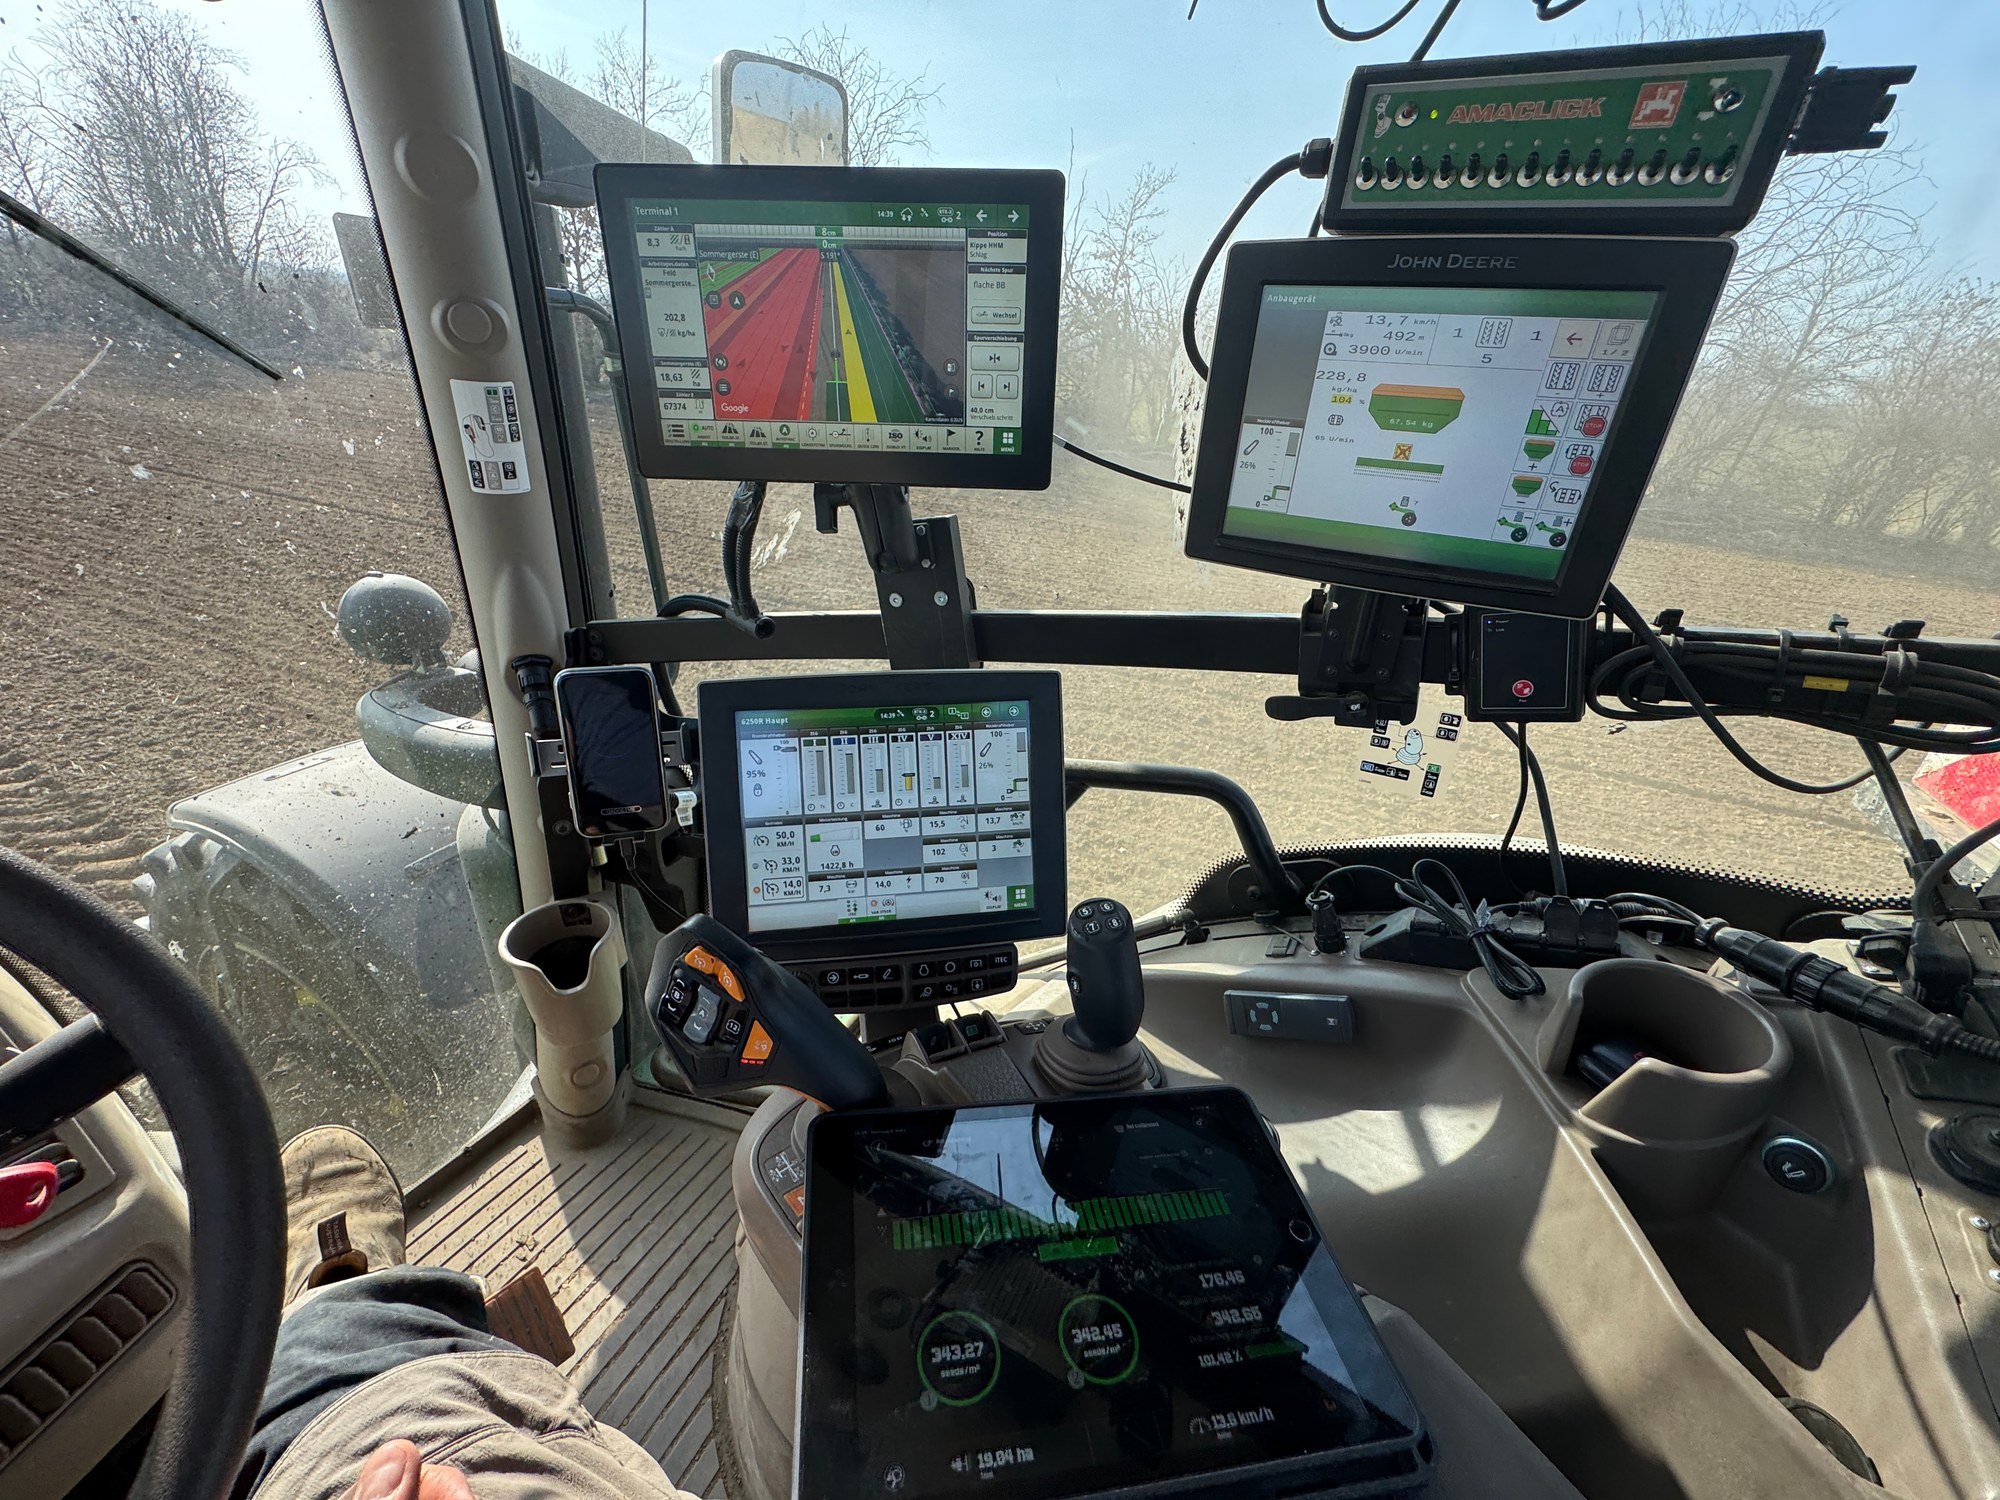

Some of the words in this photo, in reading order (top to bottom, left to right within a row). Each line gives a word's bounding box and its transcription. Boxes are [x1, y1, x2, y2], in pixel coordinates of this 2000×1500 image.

[1446, 97, 1607, 124] AMACLICK
[635, 206, 672, 216] Terminal
[674, 207, 679, 216] 1
[877, 210, 894, 218] 14:39
[956, 211, 961, 220] 2
[647, 238, 660, 248] 8,3
[969, 242, 986, 250] Kippe
[699, 250, 748, 260] Sommergerste
[750, 250, 759, 259] (E)
[969, 251, 987, 259] Schlag
[1387, 254, 1442, 268] JOHN
[1446, 254, 1519, 268] DEERE
[996, 281, 1005, 289] BB
[1267, 294, 1316, 304] Anbaugerät
[664, 313, 686, 322] 202,8
[1365, 315, 1409, 327] 13,7
[1413, 318, 1437, 326] km/h
[677, 330, 696, 338] kg/ha
[1383, 331, 1416, 341] 492
[1452, 328, 1463, 338] 1
[1530, 331, 1542, 341] 1
[1348, 345, 1391, 355] 3900
[1481, 354, 1493, 364] 5
[660, 373, 683, 382] 18,63
[1315, 370, 1367, 383] 228,8
[1331, 396, 1352, 404] 104
[663, 402, 687, 411] 67374
[721, 403, 749, 414] Google
[1422, 420, 1434, 428] kg
[888, 432, 903, 440] ISO
[1260, 427, 1274, 436] 100
[1329, 436, 1355, 444] U/min
[1239, 460, 1256, 470] 26%
[929, 710, 935, 718] 2
[741, 718, 764, 726] 6250R
[765, 717, 789, 726] Haupt
[746, 770, 766, 778] 95%
[930, 820, 946, 829] 15,5
[985, 817, 1001, 825] 13,7
[776, 831, 795, 840] 50,0
[782, 856, 800, 866] 33,0
[821, 862, 847, 871] 1422,8
[783, 880, 802, 889] 14,0
[819, 885, 831, 893] 7,3
[875, 880, 891, 889] 14,0
[994, 956, 1008, 964] iTEC
[1238, 1407, 1275, 1425] km/h
